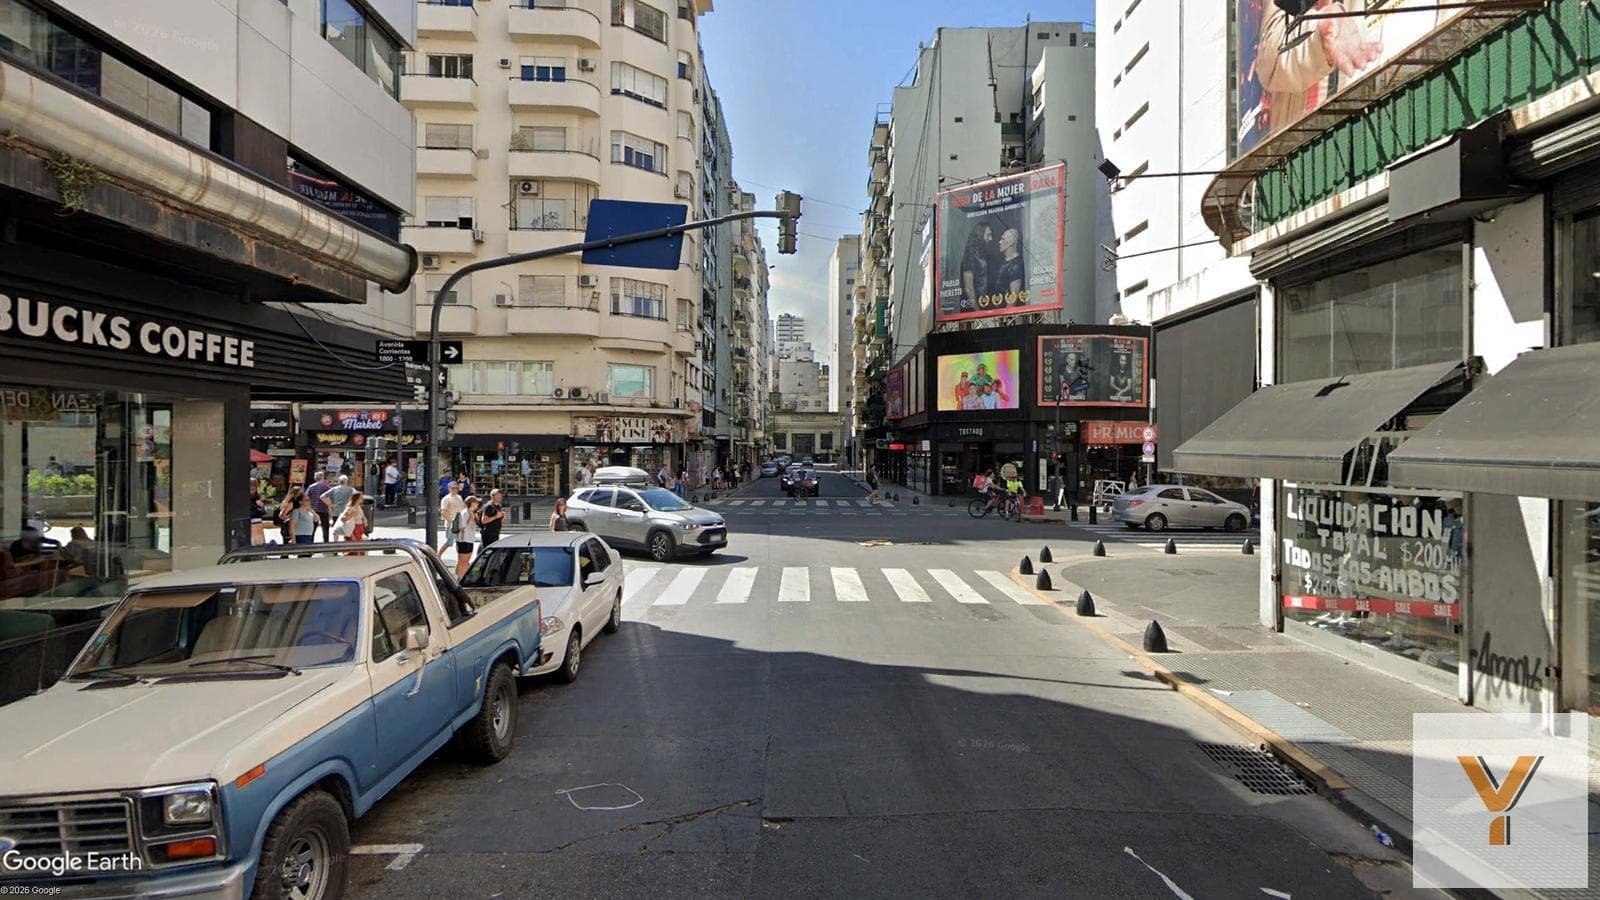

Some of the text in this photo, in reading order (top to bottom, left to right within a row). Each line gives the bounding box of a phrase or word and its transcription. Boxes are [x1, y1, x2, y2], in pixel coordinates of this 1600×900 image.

[972, 192, 983, 203] DE
[985, 189, 995, 200] LA
[997, 183, 1025, 198] MUJER
[139, 321, 255, 368] COFFEE
[343, 418, 382, 430] Market
[622, 418, 645, 428] SOLO
[622, 428, 645, 438] CINE
[959, 427, 983, 436] TOSTADO
[1317, 528, 1387, 560] TOTAL
[1282, 538, 1333, 575] TODOS
[1355, 600, 1370, 611] SALE
[1395, 602, 1411, 613] SALE
[1433, 604, 1452, 616] SALE
